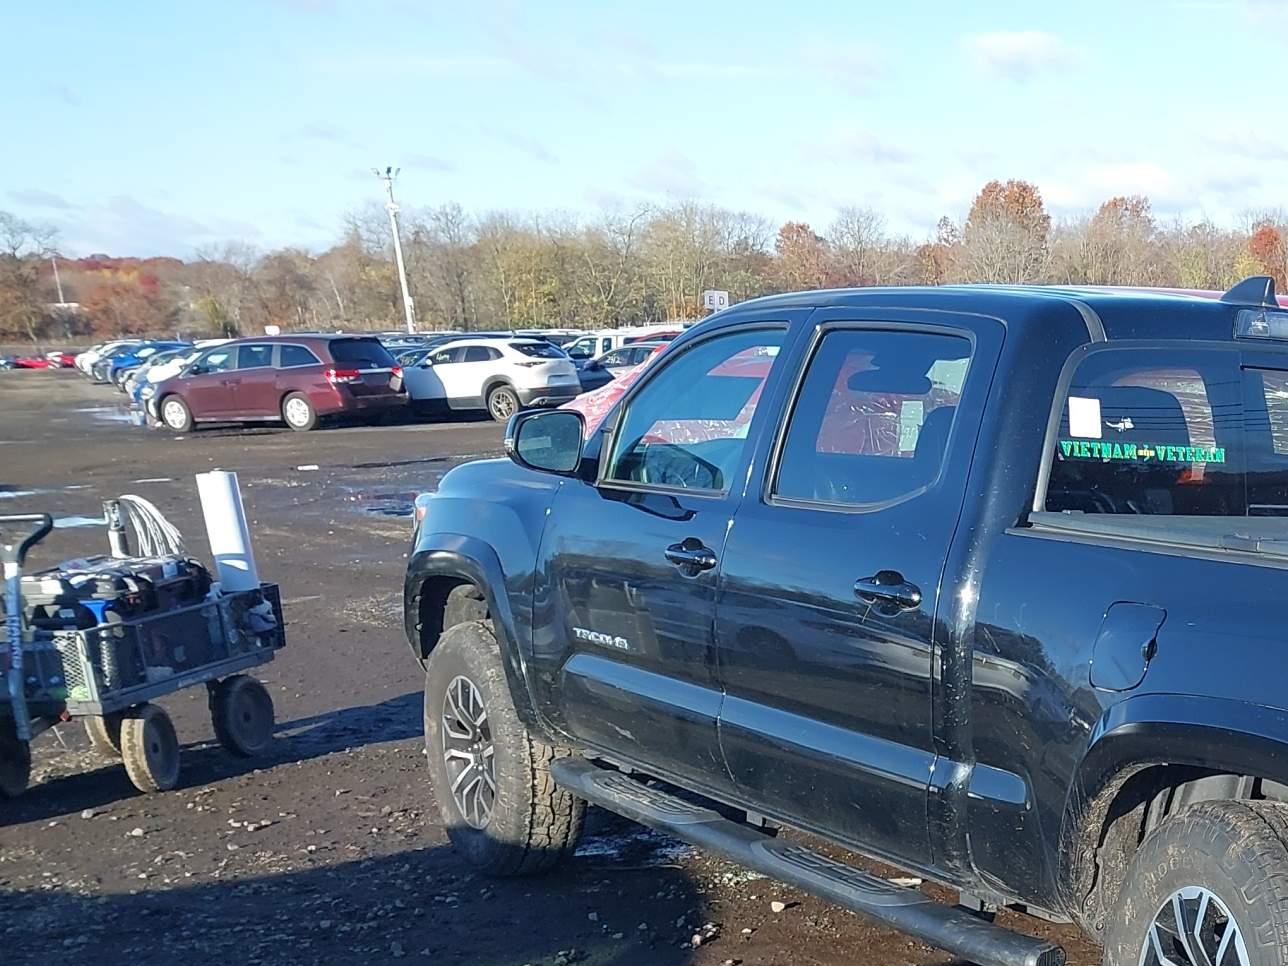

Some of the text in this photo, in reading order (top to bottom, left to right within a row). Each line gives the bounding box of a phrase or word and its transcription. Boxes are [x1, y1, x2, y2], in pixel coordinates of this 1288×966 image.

[708, 295, 715, 305] E
[1060, 440, 1226, 463] VIETNAM VETERAN
